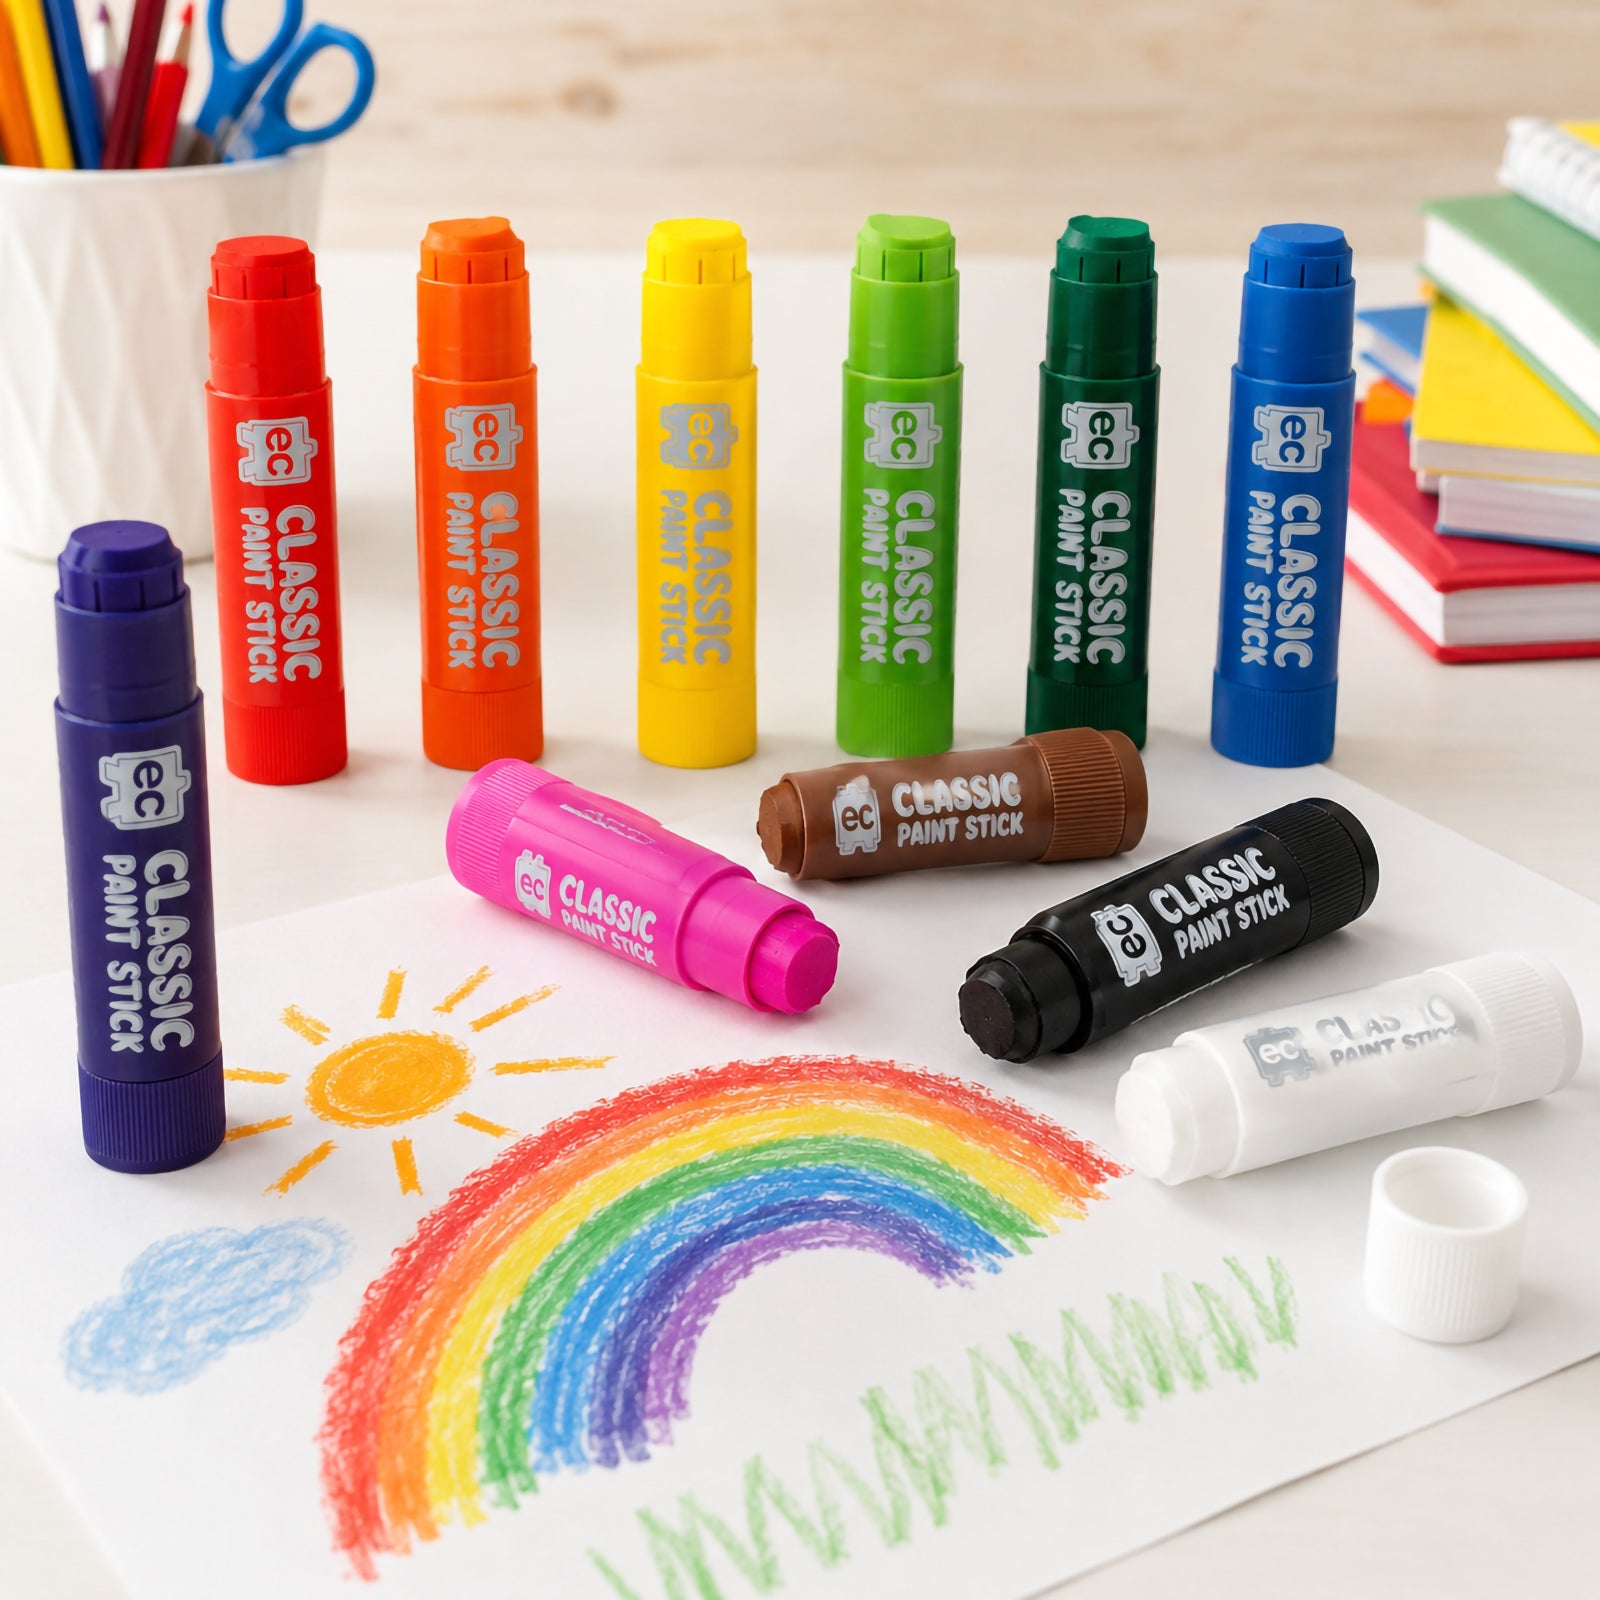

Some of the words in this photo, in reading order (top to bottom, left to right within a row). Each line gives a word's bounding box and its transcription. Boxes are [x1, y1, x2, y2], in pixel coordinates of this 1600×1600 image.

[266, 427, 294, 477] ec
[473, 413, 499, 462] ec
[688, 412, 714, 461] ec
[891, 411, 917, 460] ec
[1088, 411, 1115, 461] ec
[1279, 414, 1306, 464] ec
[241, 507, 274, 590] PAINT
[446, 493, 475, 575] PAINT
[660, 490, 688, 572] PAINT
[862, 488, 890, 572] PAINT
[1057, 489, 1086, 572] PAINT
[1246, 491, 1276, 574] PAINT
[276, 505, 322, 682] CLASSIC
[480, 492, 520, 668] CLASSIC
[693, 490, 733, 665] CLASSIC
[893, 490, 935, 664] CLASSIC
[1086, 491, 1131, 664] CLASSIC
[1274, 494, 1321, 668] CLASSIC
[245, 601, 277, 683] STICK
[447, 585, 476, 668] STICK
[660, 582, 688, 664] STICK
[860, 580, 888, 664] STICK
[1054, 580, 1083, 664] STICK
[1241, 582, 1271, 666] STICK
[133, 760, 165, 818] ec
[841, 807, 874, 830] ec
[892, 772, 1022, 817] CLASSIC
[897, 818, 960, 847] PAINT
[965, 812, 1024, 840] STICK
[102, 855, 140, 949] PAINT
[520, 872, 545, 901] ec
[559, 874, 657, 943] CLASSIC
[1149, 847, 1276, 924] CLASSIC
[1174, 908, 1230, 959] PAINT
[1235, 884, 1290, 930] STICK
[144, 849, 194, 1051] CLASSIC
[561, 909, 606, 943] PAINT
[611, 931, 658, 967] STICK
[1106, 914, 1147, 959] ec
[107, 960, 144, 1053] STICK
[1259, 1040, 1299, 1064] ec
[1330, 1038, 1396, 1066] PAINT
